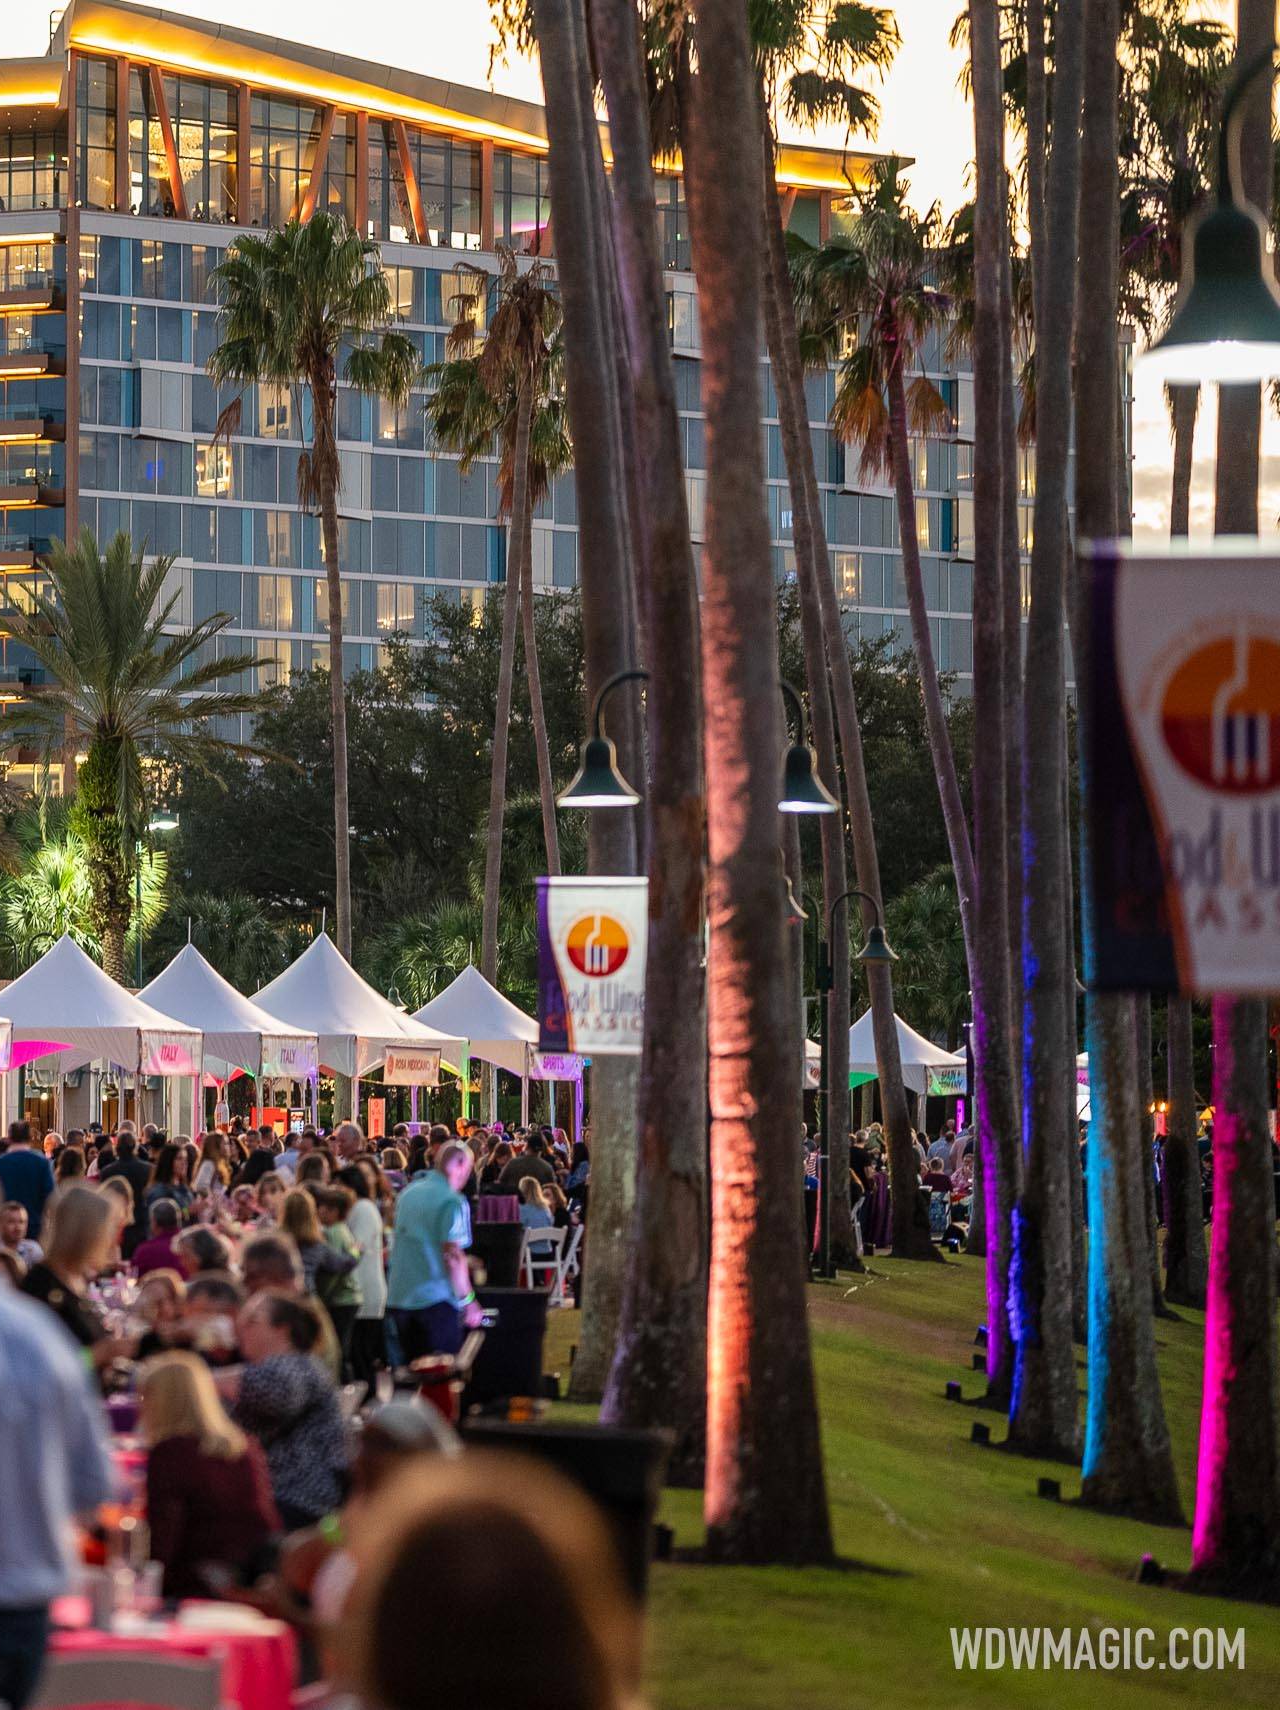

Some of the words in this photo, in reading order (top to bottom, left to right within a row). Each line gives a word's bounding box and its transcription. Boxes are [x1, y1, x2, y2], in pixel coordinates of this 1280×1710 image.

[160, 1045, 179, 1062] ITALY
[280, 1048, 297, 1064] ITALY
[543, 1055, 565, 1071] SPIRITS
